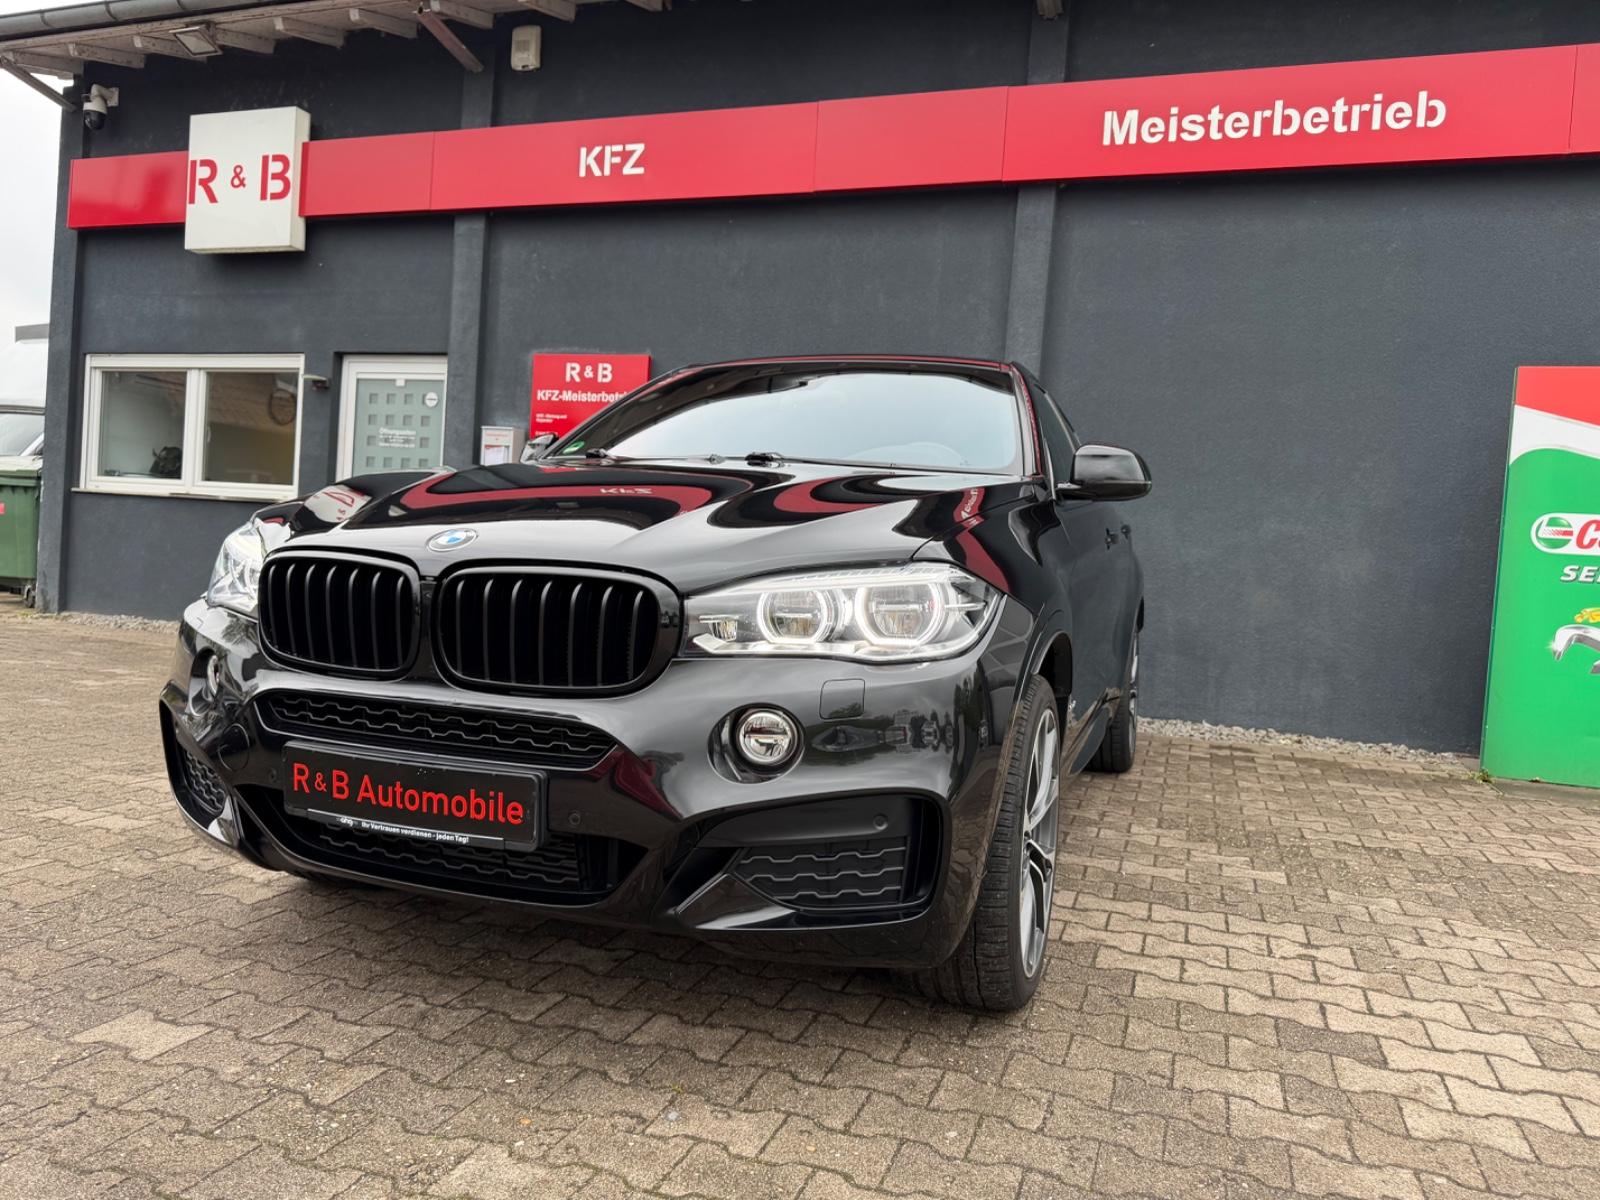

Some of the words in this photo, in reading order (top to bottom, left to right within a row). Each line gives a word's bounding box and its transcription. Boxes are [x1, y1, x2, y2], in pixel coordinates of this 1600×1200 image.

[1102, 91, 1446, 146] Meisterbetrieb
[579, 143, 645, 177] KFZ
[188, 159, 218, 204] R
[230, 165, 246, 188] &
[260, 154, 291, 200] B
[565, 362, 581, 382] R
[584, 365, 594, 378] &
[597, 363, 613, 383] B
[1576, 519, 1600, 550] C
[1560, 565, 1600, 583] SE
[293, 763, 310, 793] R
[314, 772, 327, 792] &
[332, 770, 349, 800] B
[357, 774, 523, 825] Automobile
[370, 822, 400, 833] Vertrauen
[400, 828, 432, 838] verdienen
[436, 832, 455, 841] jeden
[455, 834, 469, 844] Tag!
